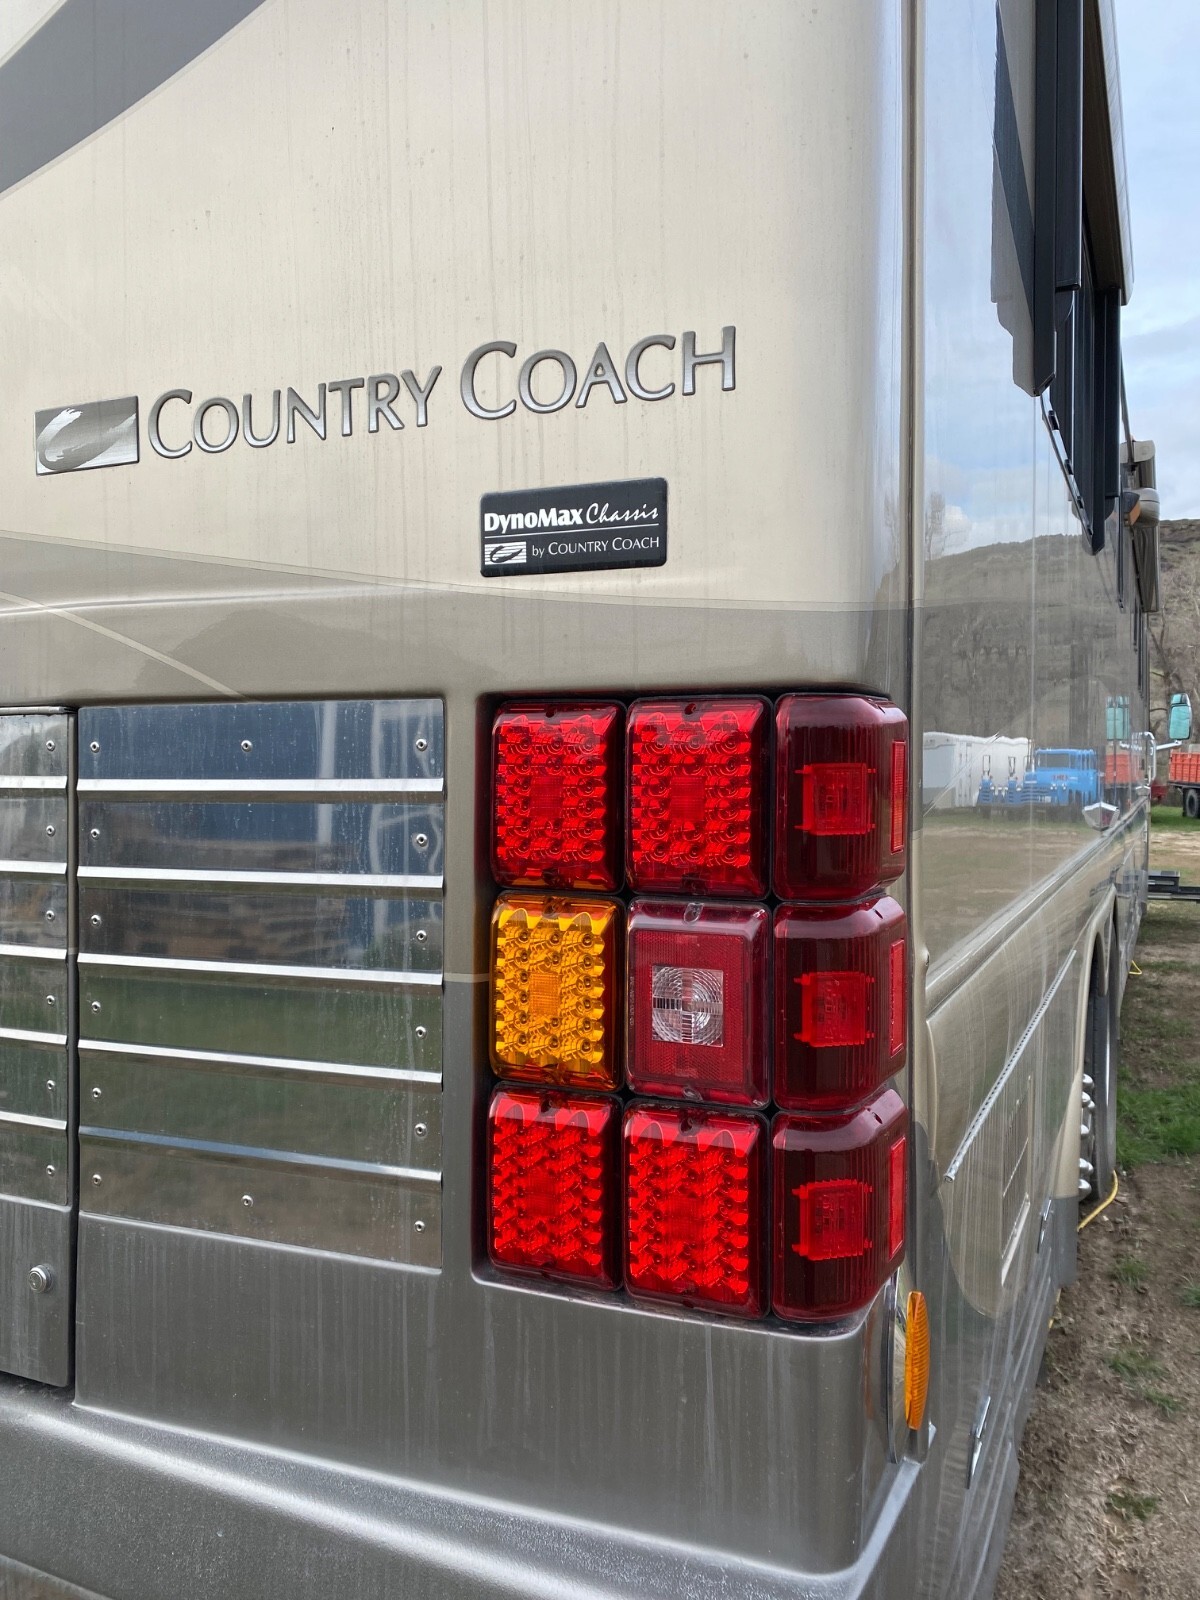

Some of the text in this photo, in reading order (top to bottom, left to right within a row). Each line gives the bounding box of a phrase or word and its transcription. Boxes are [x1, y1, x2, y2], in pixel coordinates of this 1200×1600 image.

[148, 326, 736, 459] COUNTRY COACH
[484, 503, 658, 534] DynoMax Chassis
[532, 537, 659, 558] by COUNTRY COACH
